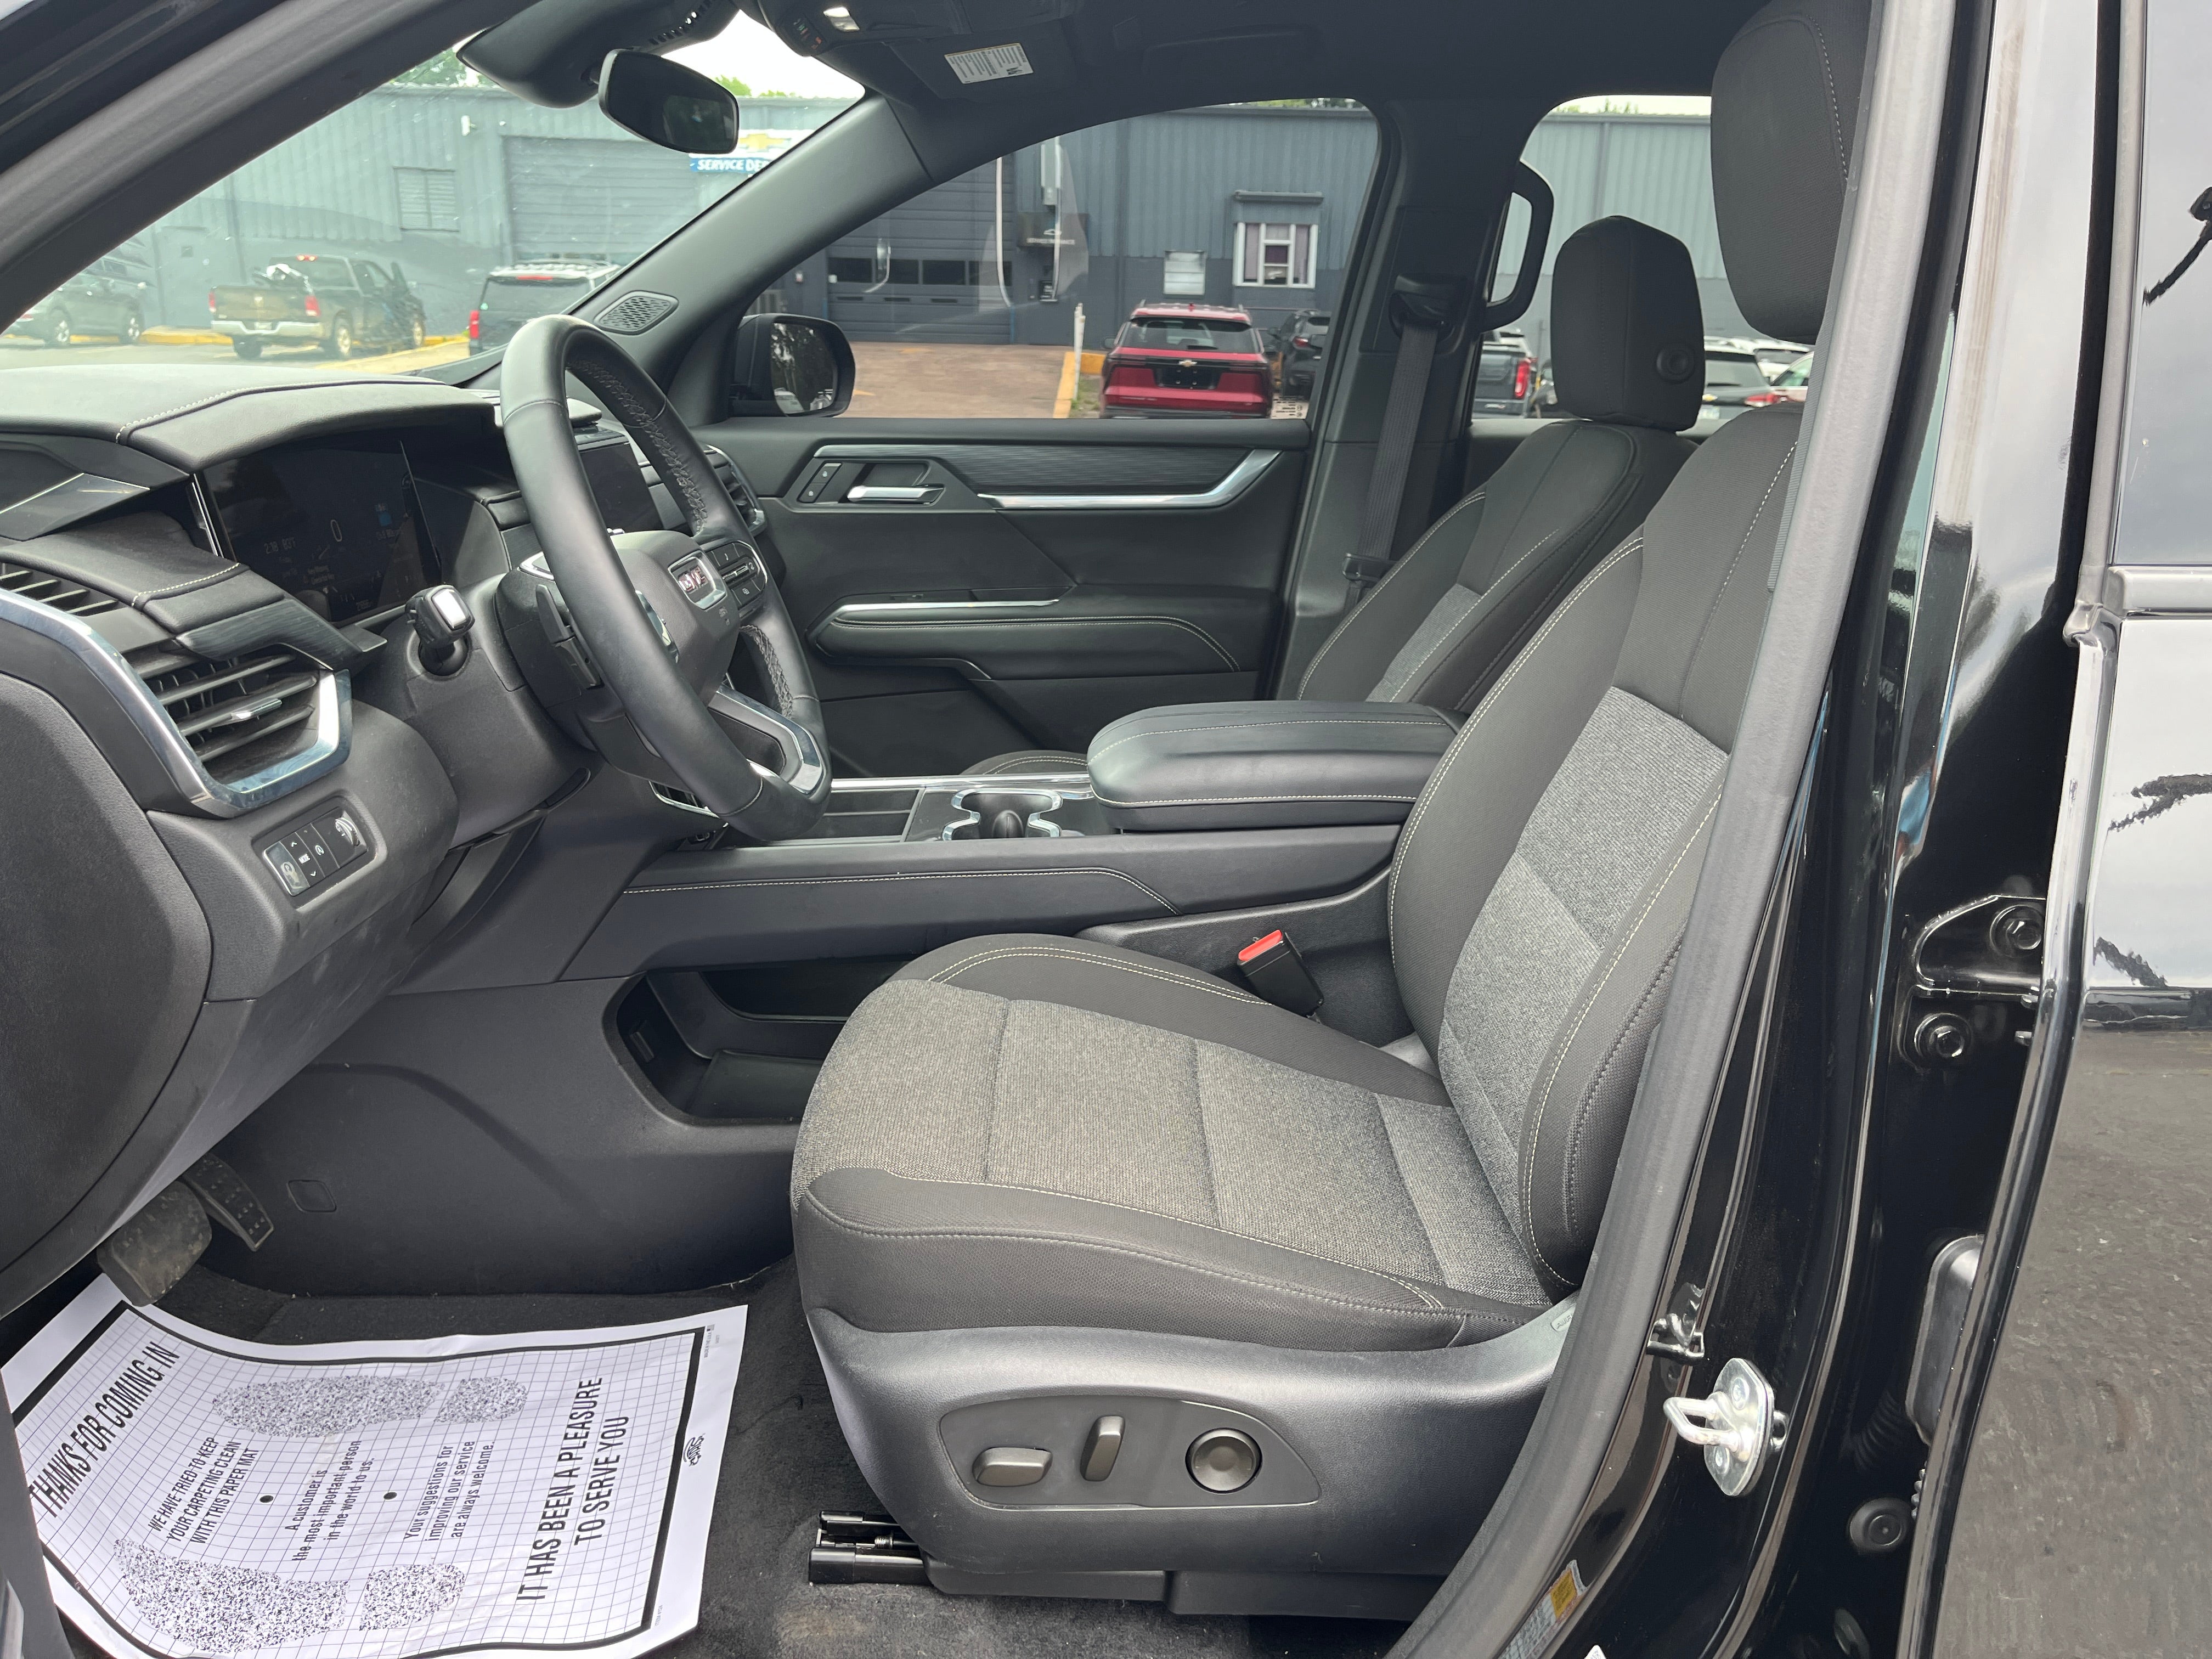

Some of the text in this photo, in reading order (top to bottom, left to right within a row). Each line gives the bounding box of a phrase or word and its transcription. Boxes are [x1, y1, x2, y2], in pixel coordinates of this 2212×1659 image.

[697, 159, 744, 171] SERVICE
[28, 1341, 180, 1518] THANKS FOR COMING IN
[148, 1437, 219, 1532] WE HAVE TRIED TO KEEP
[166, 1441, 241, 1542] YOUR CARPETING CLEAN
[190, 1448, 259, 1544] WITH THIS PAPER MAT
[292, 1480, 321, 1521] customer
[312, 1470, 328, 1478] is
[292, 1440, 362, 1561] the most important person
[323, 1458, 375, 1540] in the world to us.
[403, 1446, 454, 1540] Your suggestions for
[425, 1441, 475, 1541] improving our service
[451, 1441, 495, 1538] are always welcome.
[516, 1377, 603, 1600] IT HAS BEEN A PLEASURE
[573, 1416, 629, 1546] TO SERVE YOU
